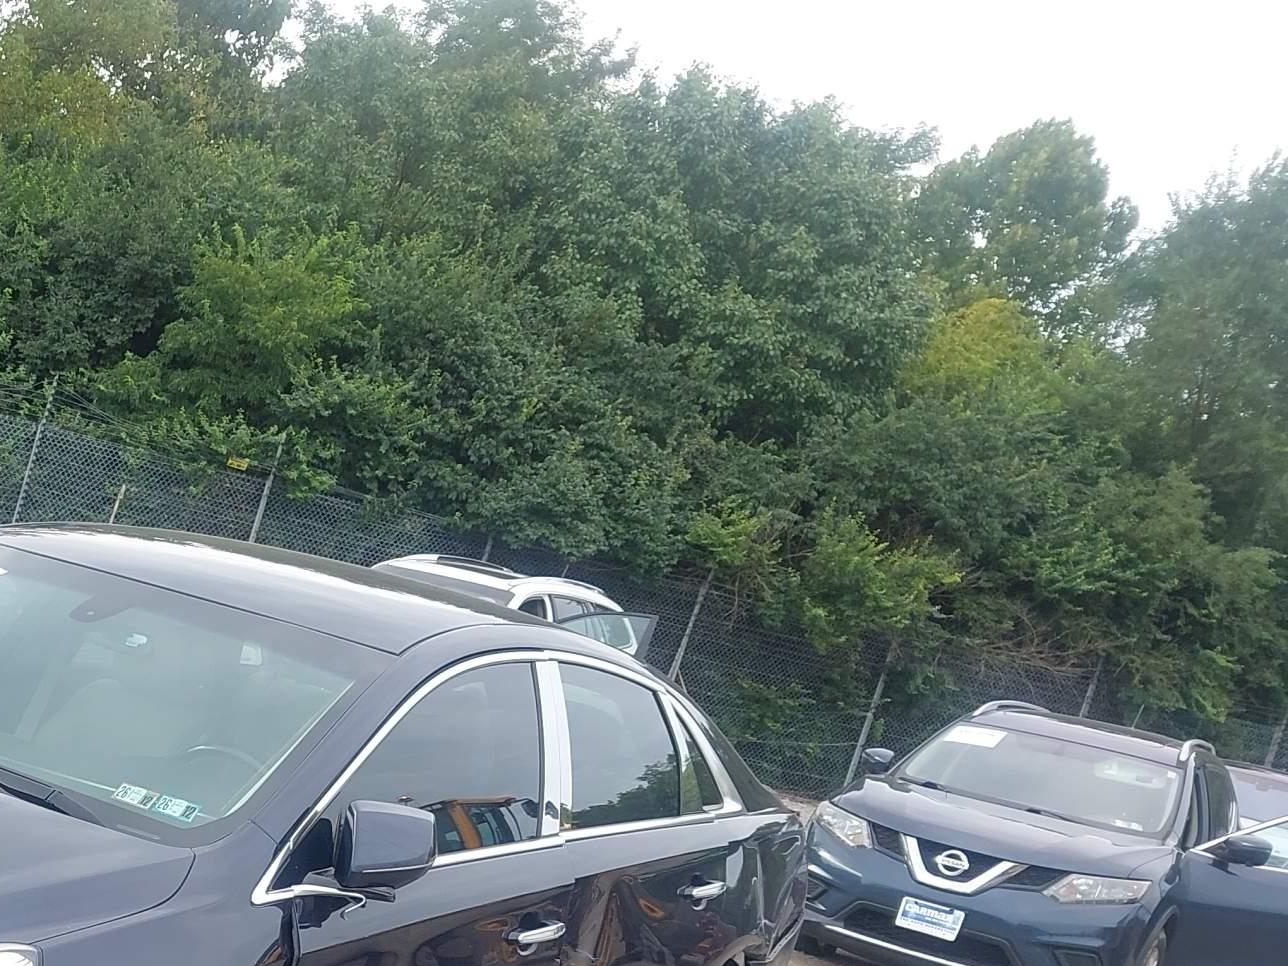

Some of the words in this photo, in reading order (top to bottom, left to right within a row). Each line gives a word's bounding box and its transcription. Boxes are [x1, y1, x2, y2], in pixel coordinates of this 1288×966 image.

[116, 785, 131, 799] 26
[140, 795, 153, 807] 12
[157, 797, 173, 810] 26
[181, 804, 197, 820] 12
